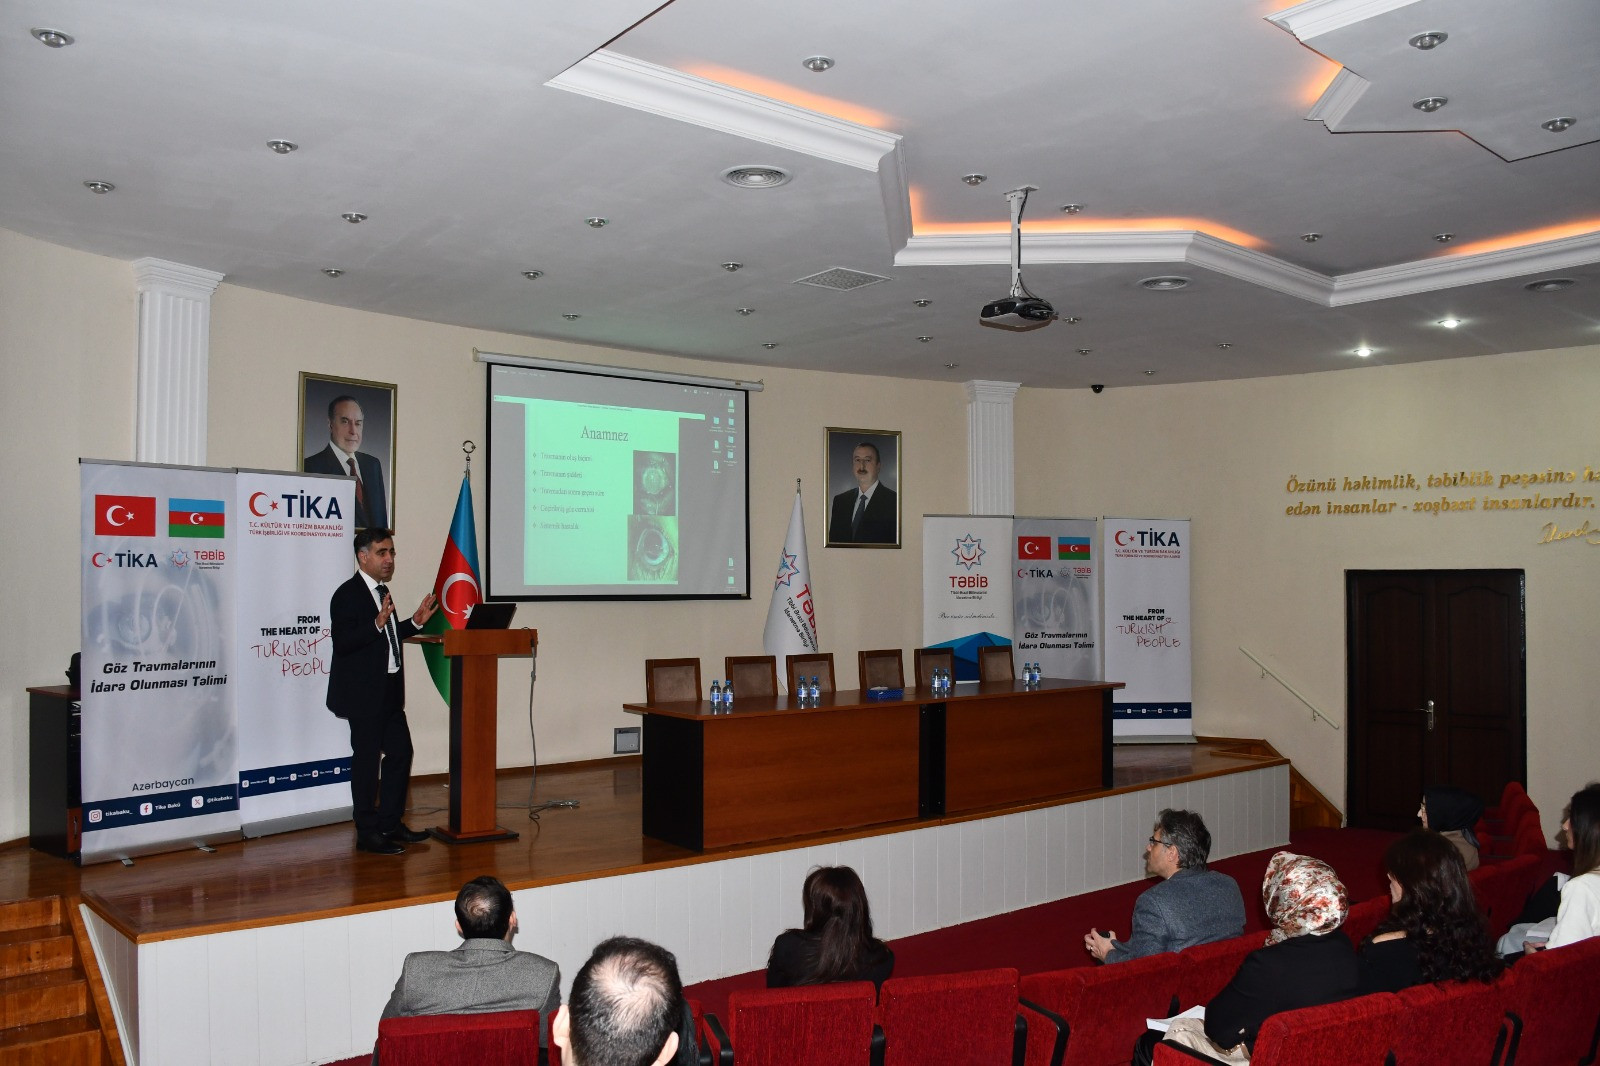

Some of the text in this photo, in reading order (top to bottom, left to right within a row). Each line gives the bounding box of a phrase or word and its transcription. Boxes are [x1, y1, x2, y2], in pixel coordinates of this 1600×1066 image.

[580, 425, 629, 442] Anamnez
[1286, 474, 1337, 493] Özünü
[1342, 473, 1421, 491] həkimlik,
[1427, 470, 1494, 488] təbiblik
[1498, 467, 1577, 489] peşəsinə
[281, 489, 343, 519] TİKA
[1285, 501, 1322, 516] edən
[1327, 499, 1397, 515] insanlar
[1412, 496, 1477, 517] xoşbəxt
[1482, 492, 1596, 510] insanlardır.
[1136, 528, 1180, 547] TİKA
[115, 549, 158, 568] TİKA
[194, 549, 225, 561] TƏBİB
[1029, 567, 1054, 578] TİKA
[949, 574, 988, 588] TƏBİB
[297, 615, 320, 624] FROM
[261, 626, 320, 636] THE HEART OF
[1115, 622, 1164, 635] TURKISH
[250, 638, 318, 658] TURKISH
[1136, 635, 1181, 648] PEOPLE
[103, 659, 216, 674] Göz Travmalarının
[282, 657, 331, 677] PEOPL
[90, 675, 228, 693] İdarə Olunması Təlimi
[132, 776, 195, 792] Azərbaycan
